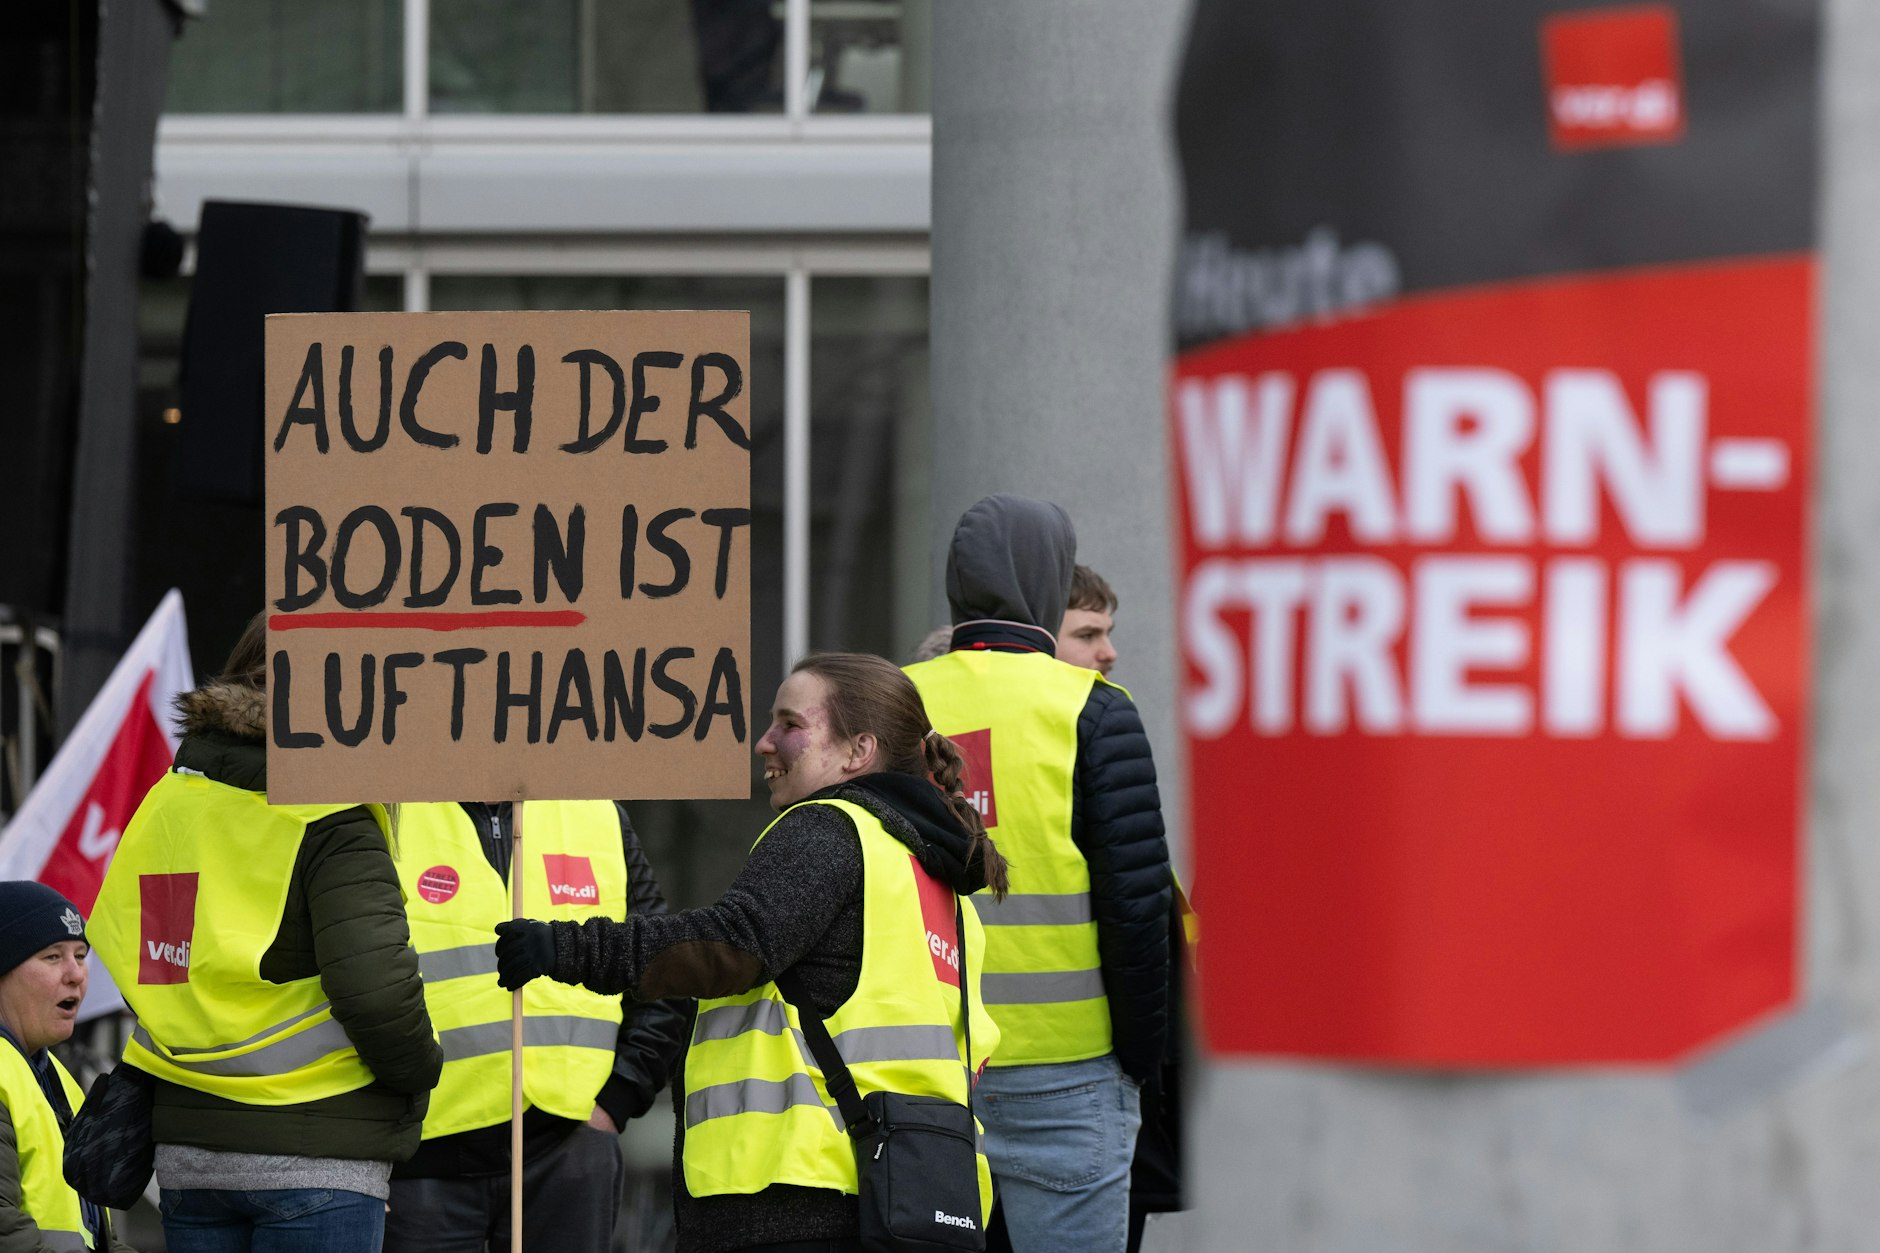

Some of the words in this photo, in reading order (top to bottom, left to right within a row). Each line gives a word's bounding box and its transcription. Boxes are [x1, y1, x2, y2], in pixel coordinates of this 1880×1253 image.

[273, 341, 535, 454] AUCH
[558, 349, 750, 454] DER
[1176, 366, 1791, 549] WARN-
[273, 502, 586, 612] BODEN
[619, 504, 750, 600] IST
[272, 647, 746, 748] LUFTHANSA
[1182, 555, 1780, 741] STREIK
[551, 884, 596, 898] ver.di
[926, 930, 960, 974] er.d
[935, 1210, 976, 1230] Bench.
